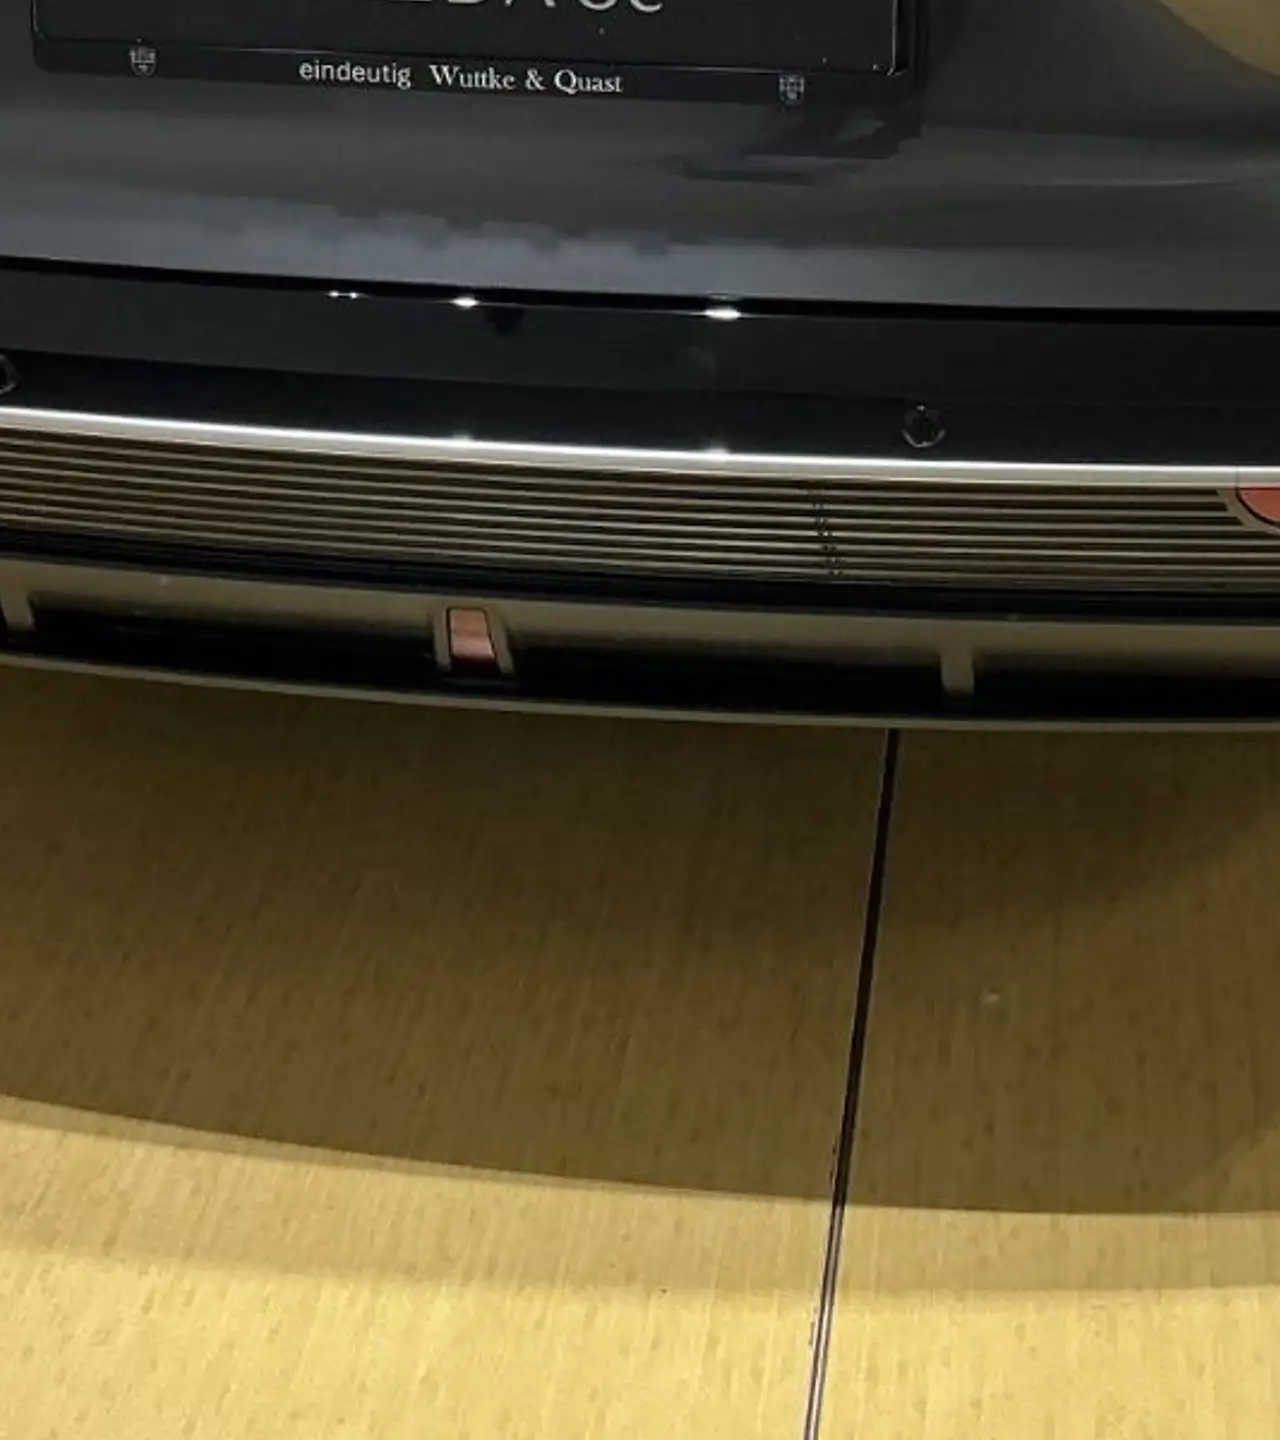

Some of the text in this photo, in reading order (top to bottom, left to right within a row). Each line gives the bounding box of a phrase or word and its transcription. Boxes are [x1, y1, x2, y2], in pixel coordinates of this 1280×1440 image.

[298, 60, 624, 96] eindeutig Wuttke & Quast
